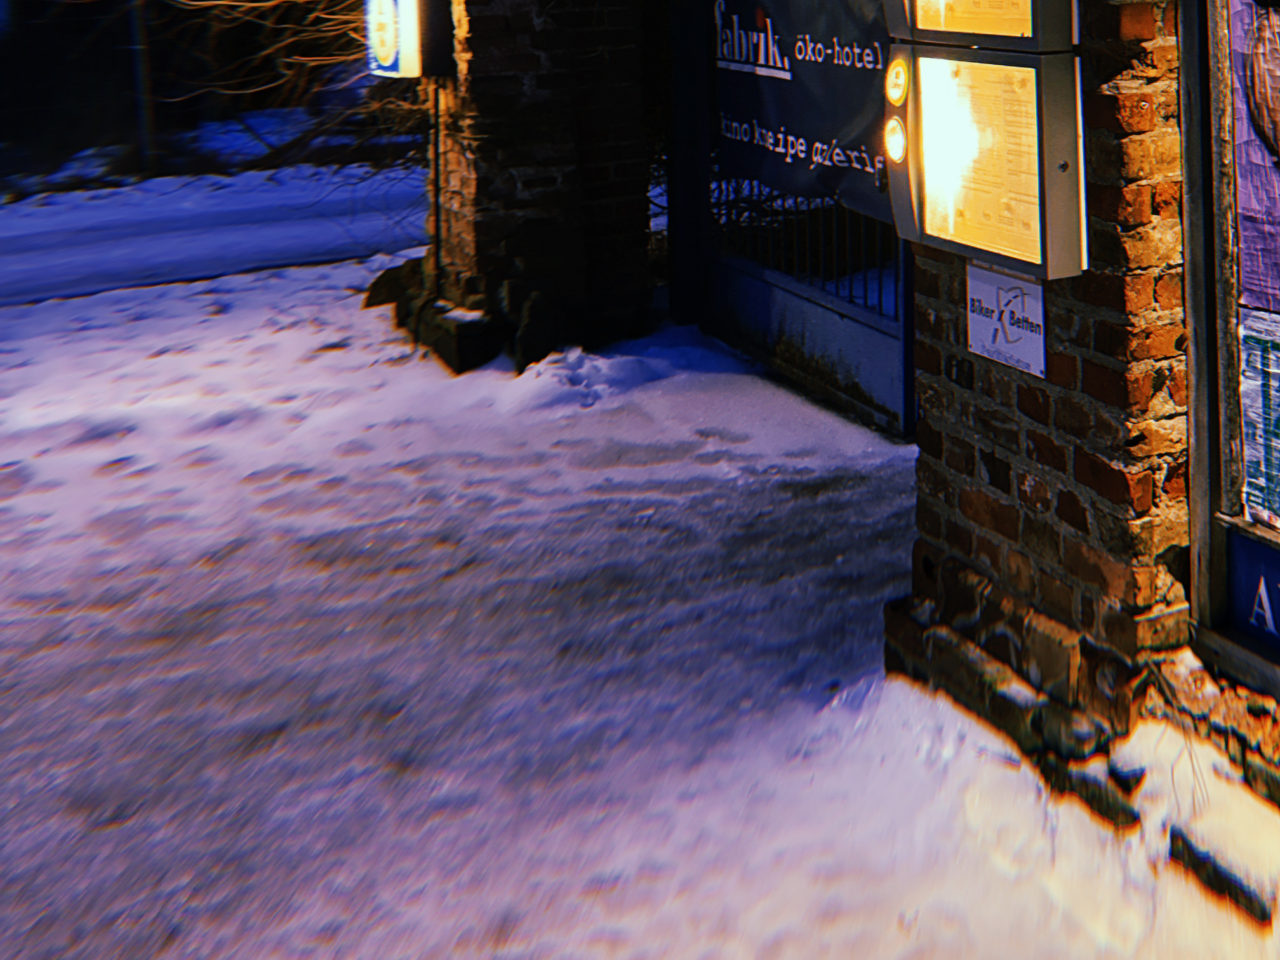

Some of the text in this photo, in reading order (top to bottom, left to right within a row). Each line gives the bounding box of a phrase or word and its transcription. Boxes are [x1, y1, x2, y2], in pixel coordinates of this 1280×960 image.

[794, 34, 884, 70] öko-hotel
[970, 297, 996, 320] Biker
[1009, 309, 1042, 336] Betten
